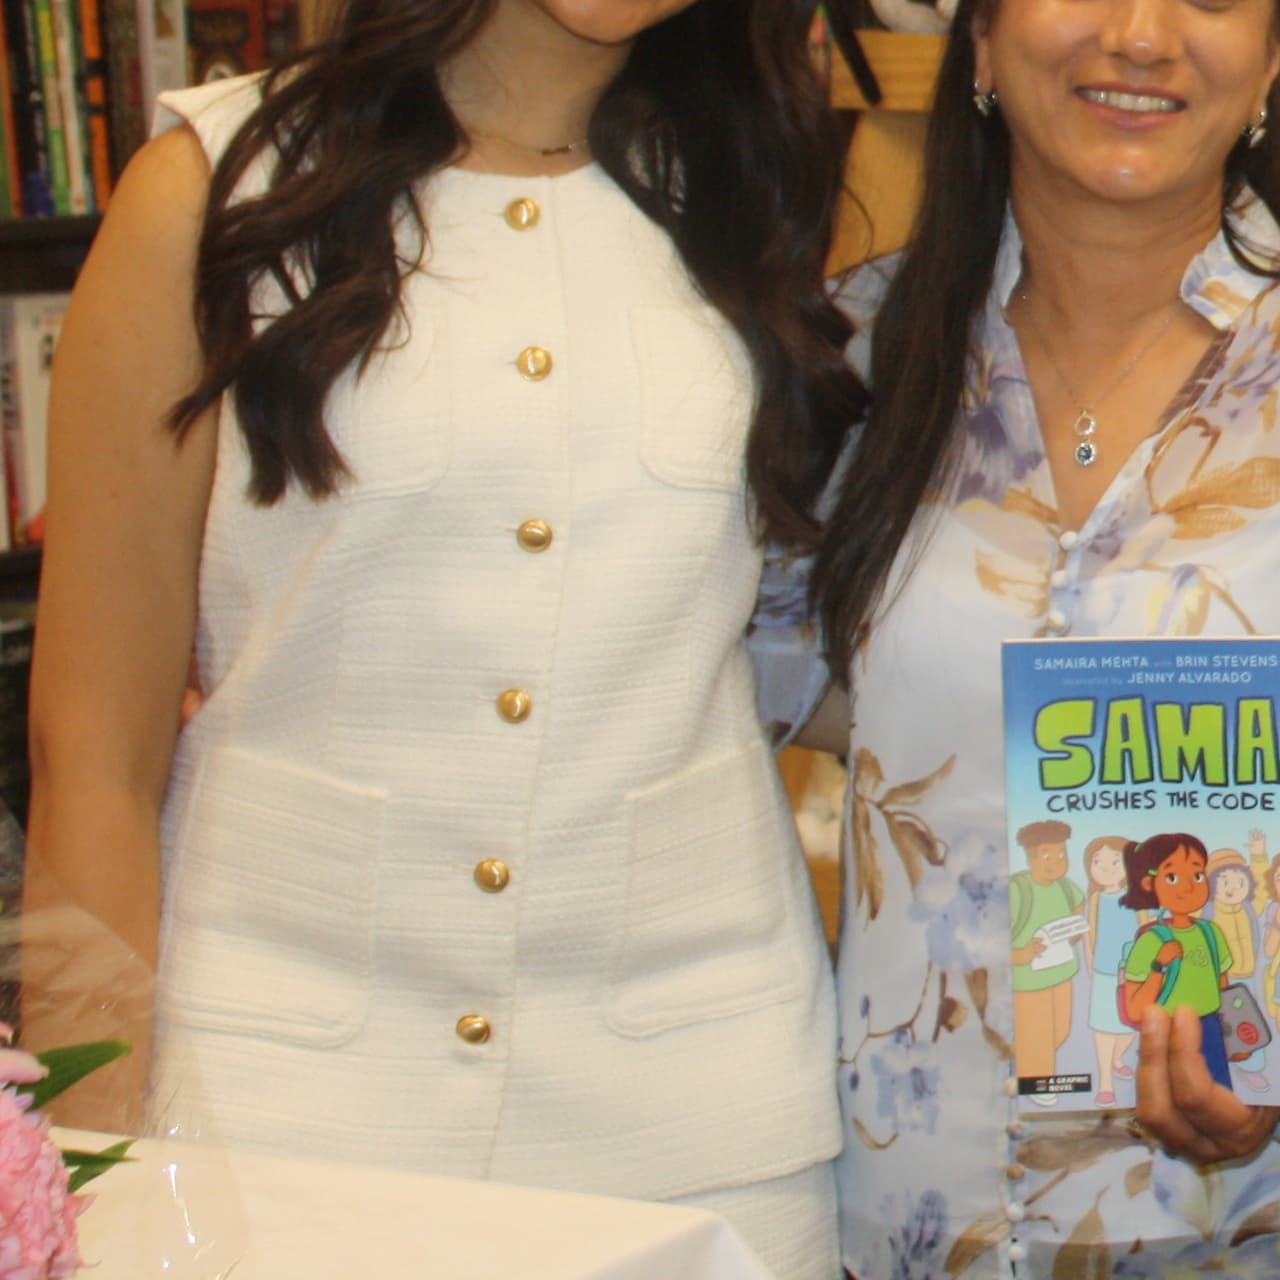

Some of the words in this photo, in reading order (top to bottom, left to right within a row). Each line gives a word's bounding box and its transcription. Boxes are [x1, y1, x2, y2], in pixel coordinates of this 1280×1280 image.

[1033, 656, 1097, 670] SAMAIRA
[1101, 656, 1149, 669] MEHTA
[1175, 655, 1208, 668] BRIN
[1212, 655, 1279, 668] STEVENS
[1127, 671, 1174, 684] JENNY
[1178, 670, 1252, 684] ALVARADO
[1046, 789, 1157, 813] CRUSHES
[1165, 790, 1200, 809] THE
[1205, 791, 1277, 812] CODE
